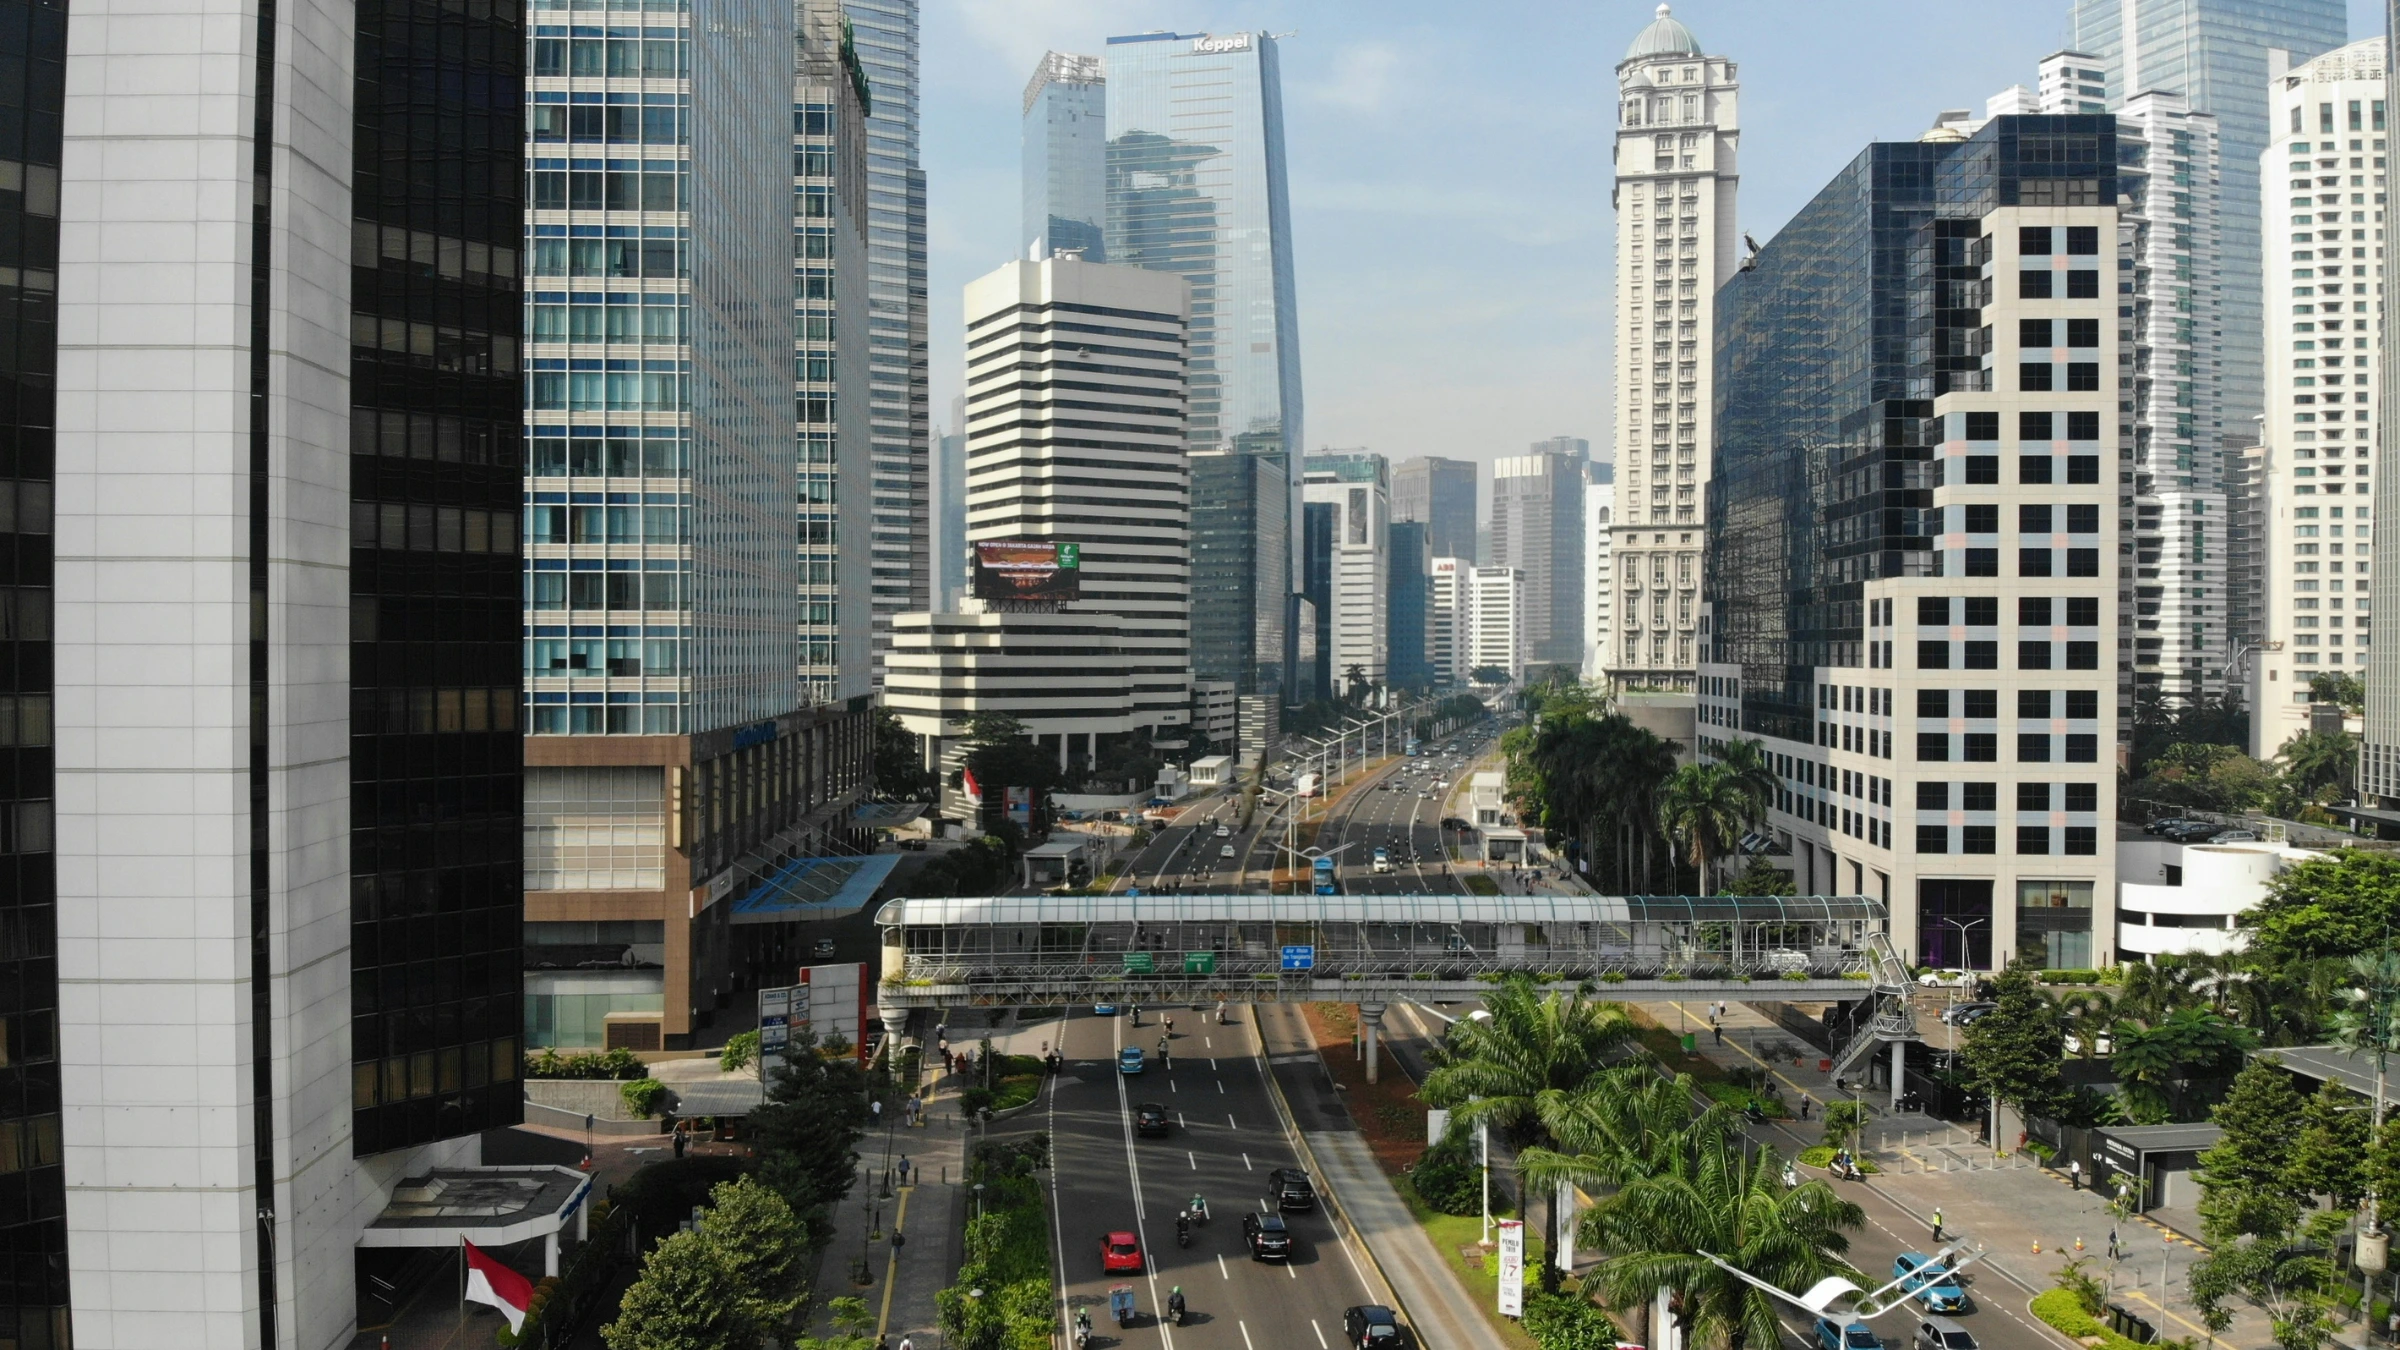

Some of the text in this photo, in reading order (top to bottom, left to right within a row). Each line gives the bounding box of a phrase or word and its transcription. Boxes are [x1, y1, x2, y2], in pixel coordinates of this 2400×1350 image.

[1194, 35, 1248, 52] Keppel
[1437, 563, 1455, 571] ABB
[1503, 1263, 1518, 1277] 17
